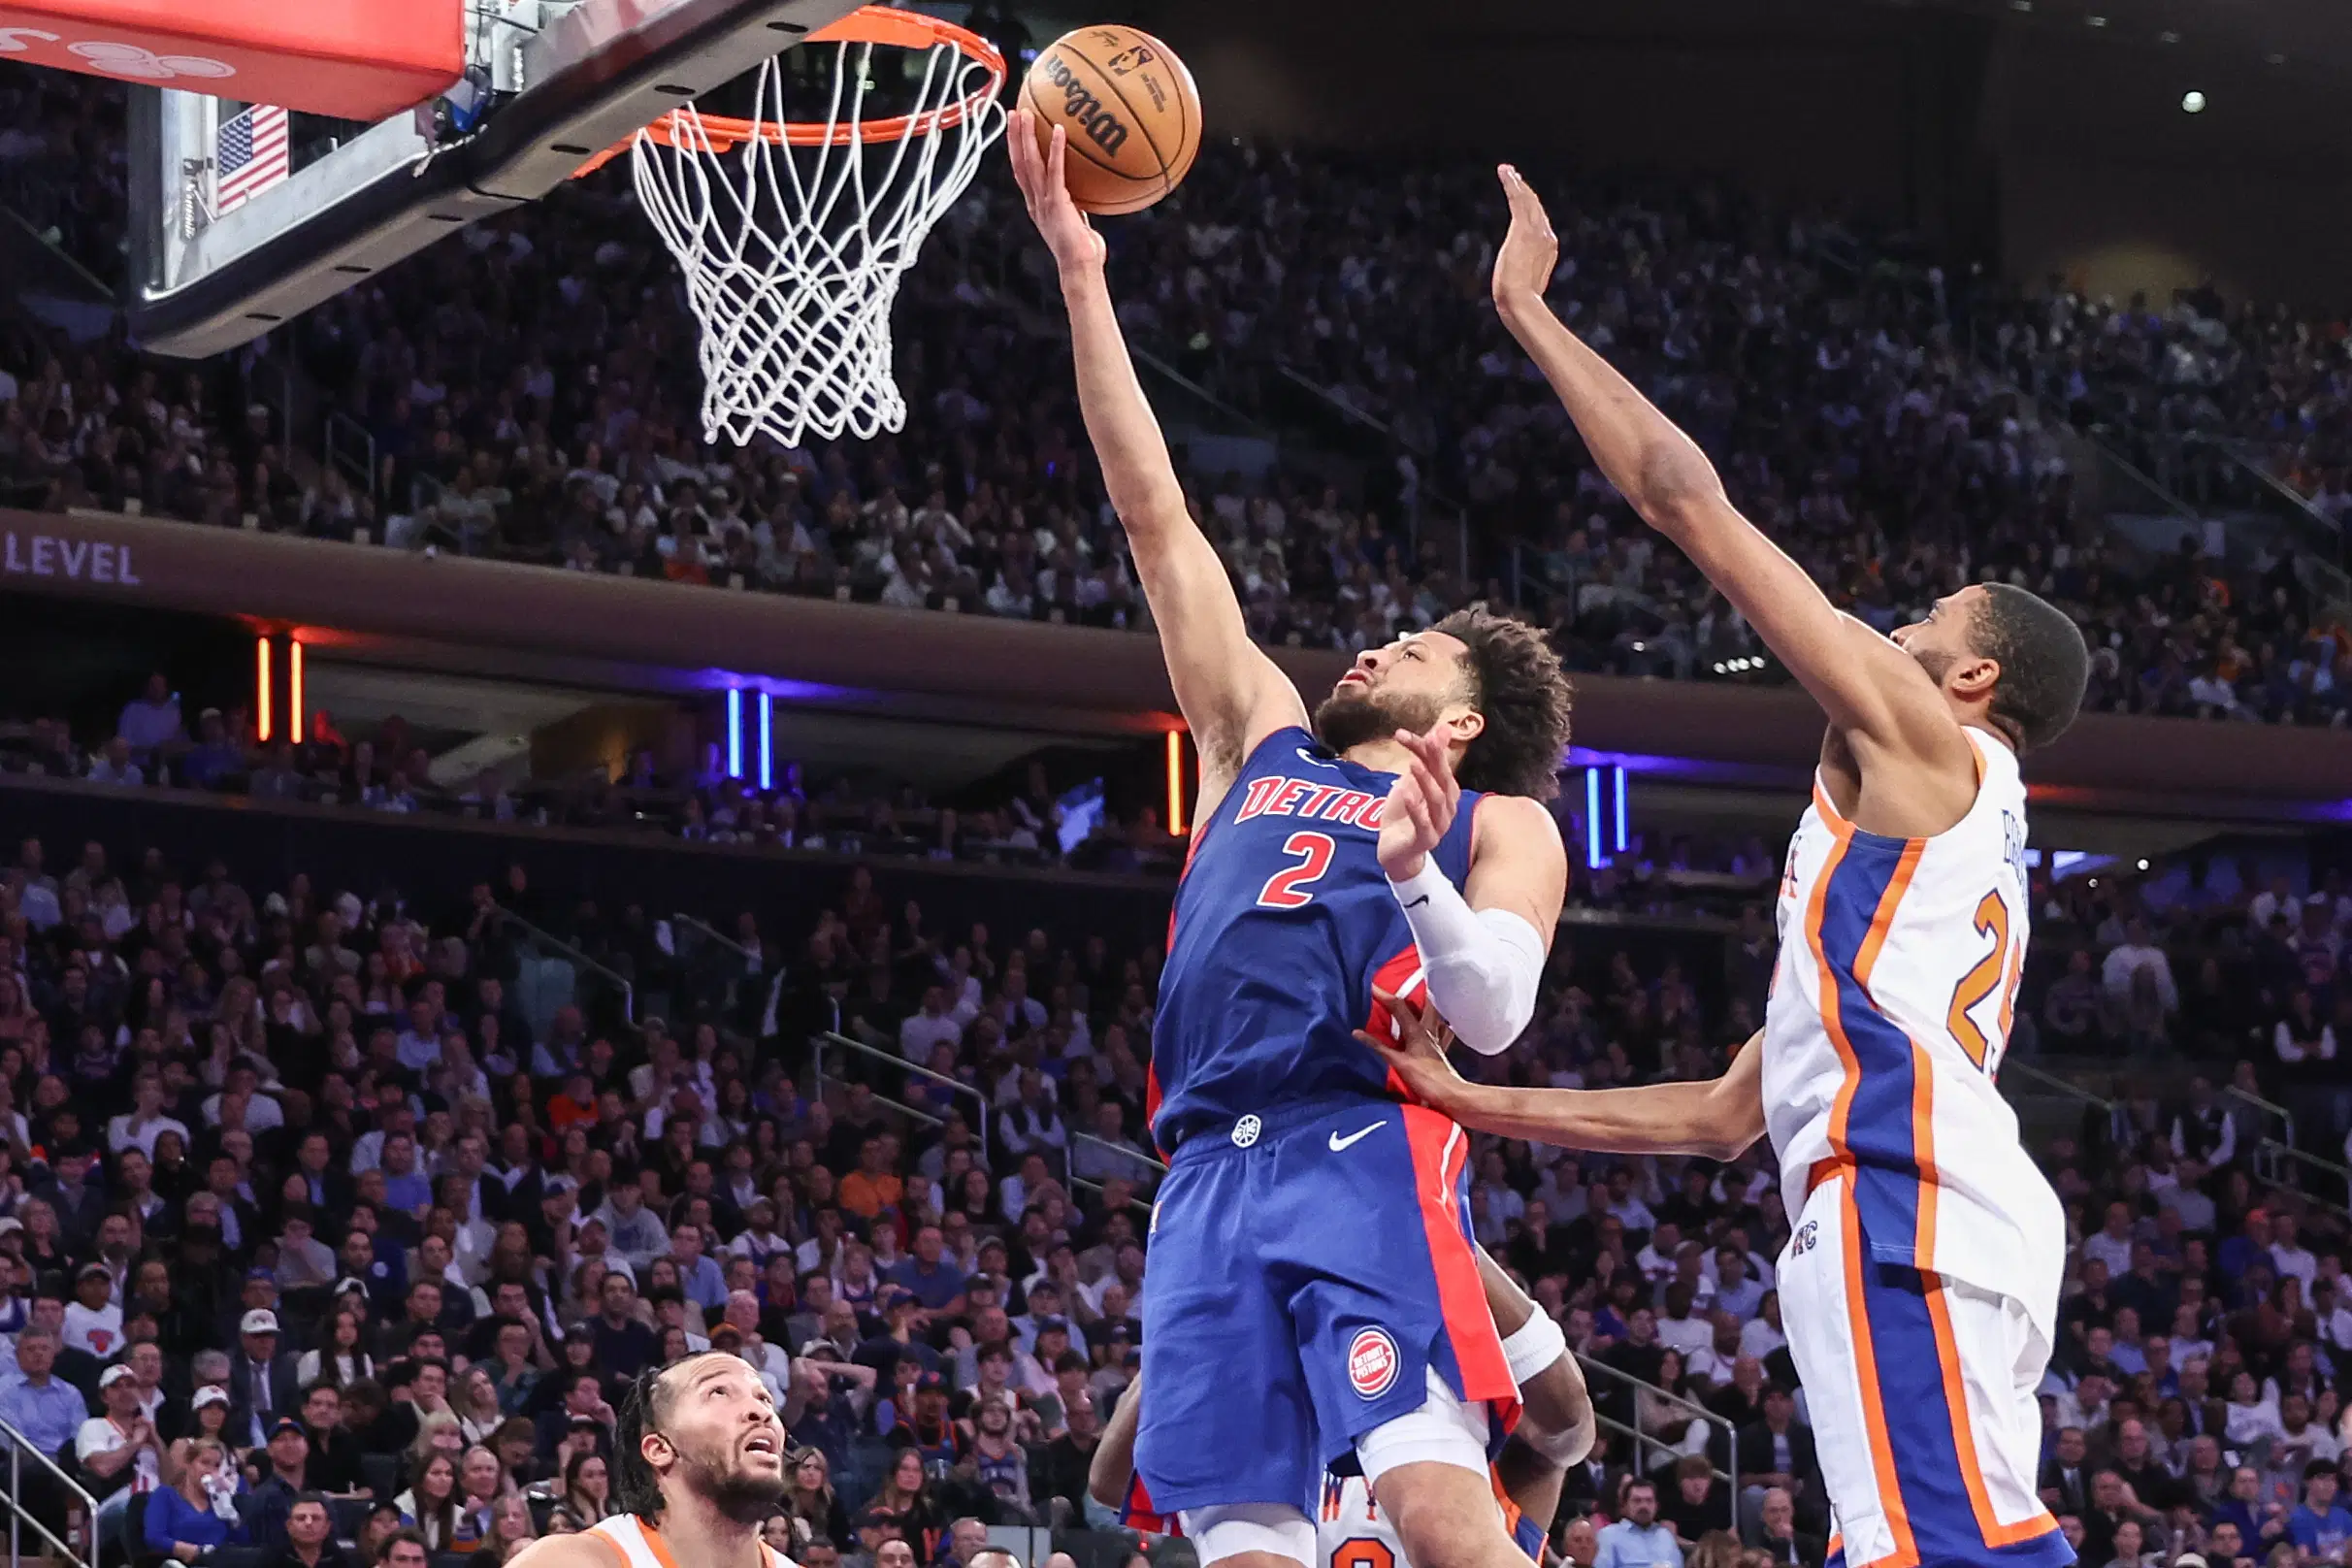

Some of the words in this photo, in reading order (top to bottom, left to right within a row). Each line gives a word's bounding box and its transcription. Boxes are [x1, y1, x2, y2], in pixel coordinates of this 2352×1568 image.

[5, 530, 142, 585] LEVEL
[1234, 775, 1385, 832] DETRO
[1257, 831, 1337, 909] 2
[1354, 1344, 1385, 1369] DETROIT
[1355, 1354, 1388, 1380] PISTONS
